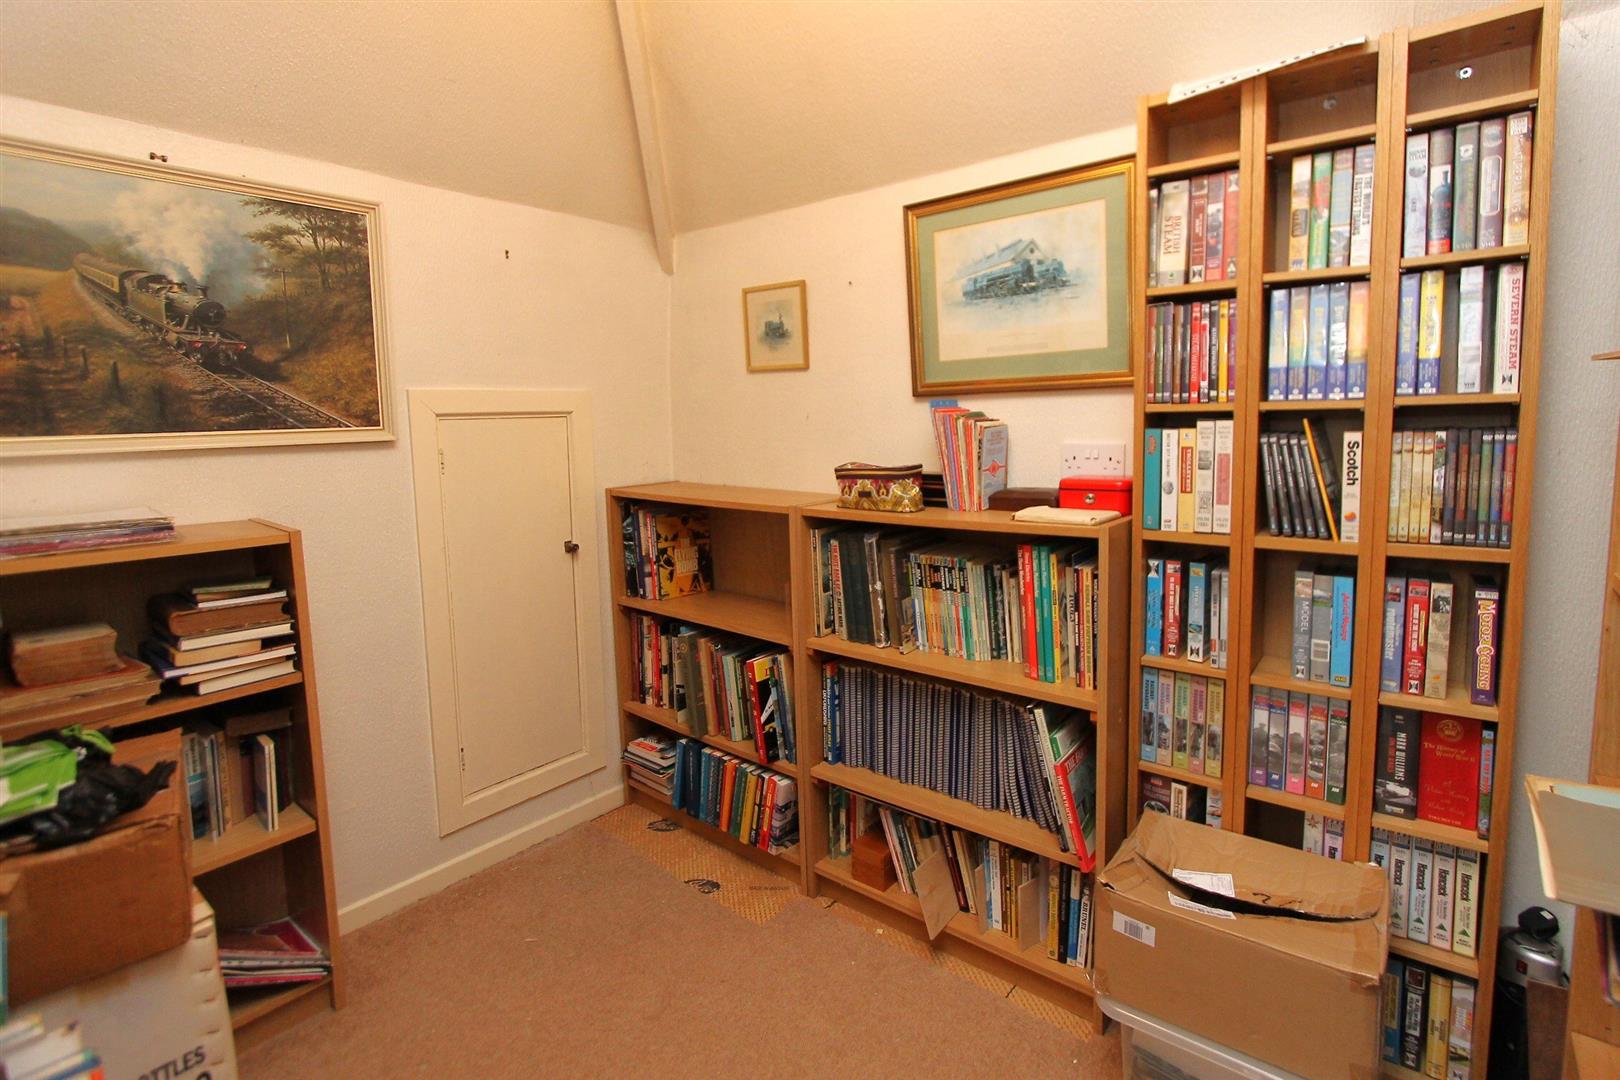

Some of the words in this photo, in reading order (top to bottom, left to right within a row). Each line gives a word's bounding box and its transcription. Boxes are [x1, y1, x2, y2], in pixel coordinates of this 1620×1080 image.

[1163, 214, 1173, 255] STEAM
[1172, 215, 1182, 254] BRITISH
[1511, 278, 1520, 325] SEVERN
[1509, 329, 1518, 370] STEAM
[1346, 440, 1360, 486] Scotch
[1300, 601, 1310, 633] MODEL
[1478, 600, 1496, 643] MOTOR
[1396, 731, 1407, 750] MARK
[1394, 750, 1406, 781] WILLIAMS
[1394, 858, 1406, 887] Hancock
[1416, 863, 1428, 891] Hancock
[1438, 868, 1450, 897] Hancock
[1460, 873, 1473, 902] Hancock
[1080, 901, 1089, 932] BRUNEL
